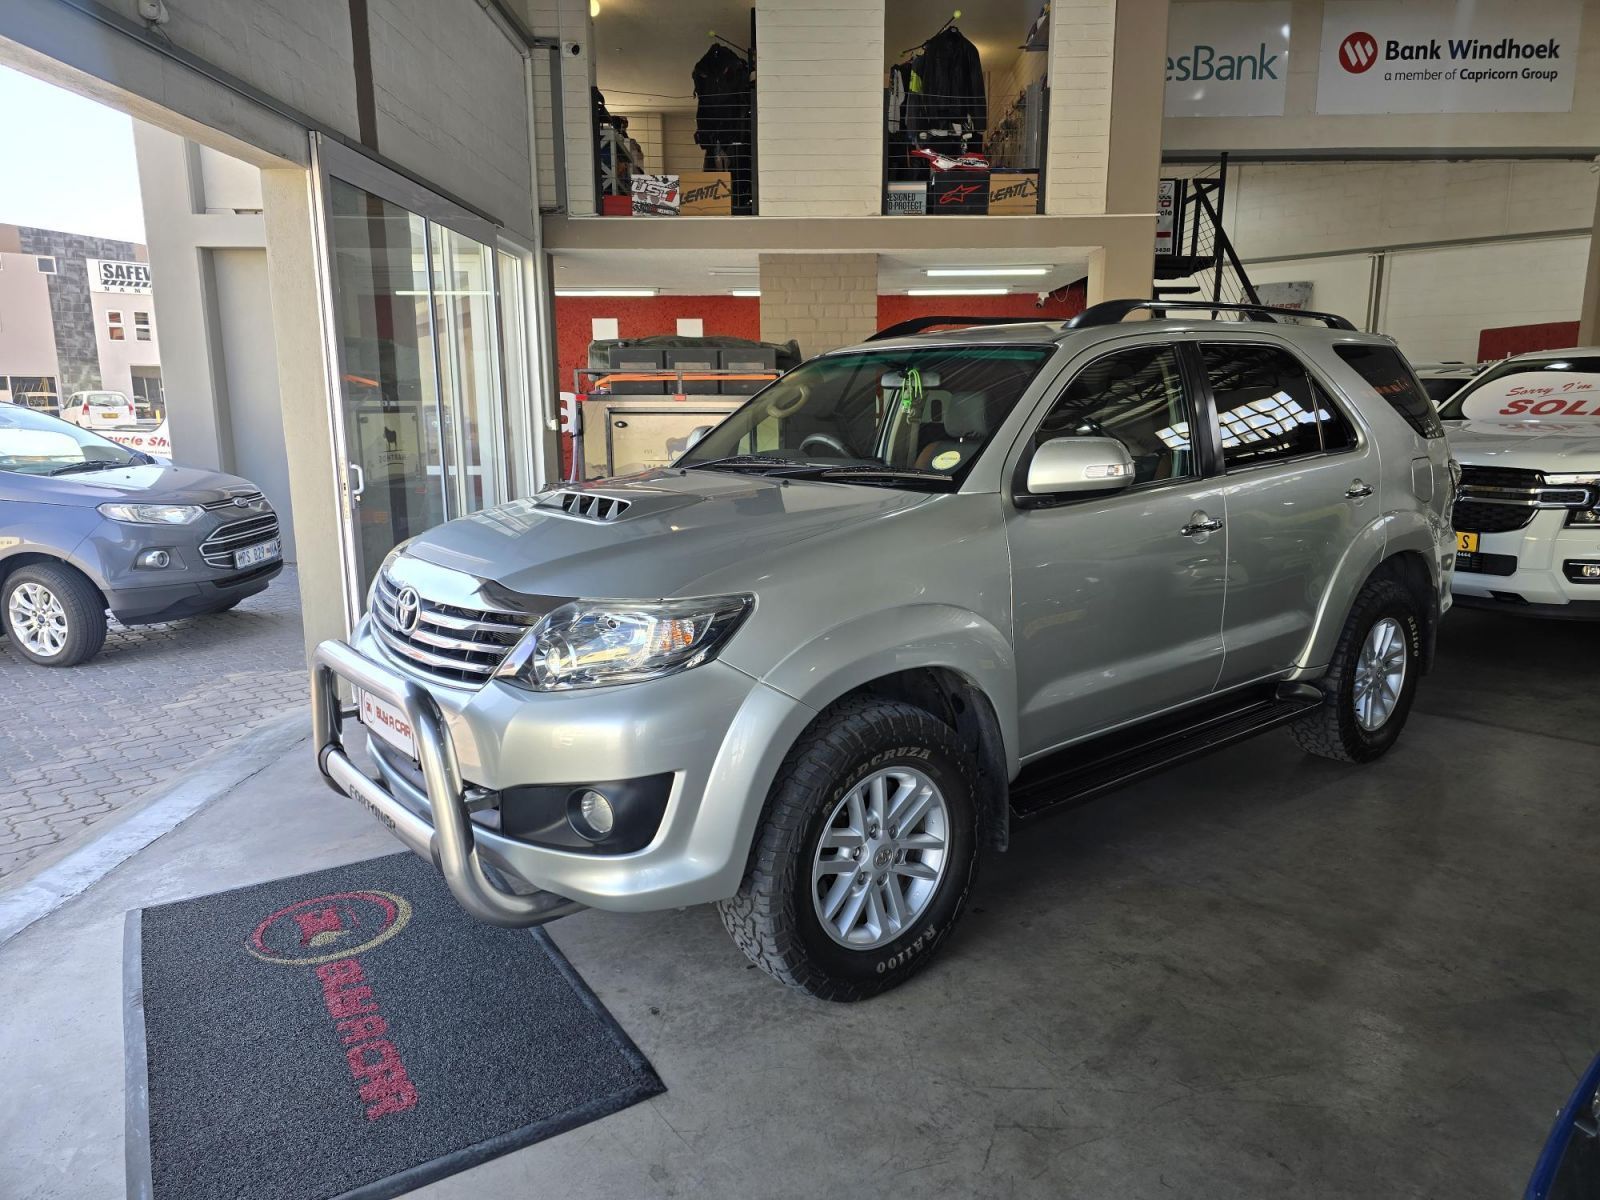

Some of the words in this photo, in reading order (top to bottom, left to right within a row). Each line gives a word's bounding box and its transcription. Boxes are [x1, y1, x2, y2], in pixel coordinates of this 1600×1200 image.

[1385, 39, 1442, 60] Bank
[1448, 38, 1560, 60] Windhoek
[1384, 72, 1392, 81] a
[1394, 69, 1442, 81] member
[1445, 68, 1458, 80] of
[1460, 68, 1518, 82] Capricorn
[1521, 67, 1558, 82] Group
[1505, 386, 1554, 397] Sorry
[1562, 381, 1593, 392] I'm
[147, 436, 171, 447] Sh
[1462, 534, 1470, 549] S
